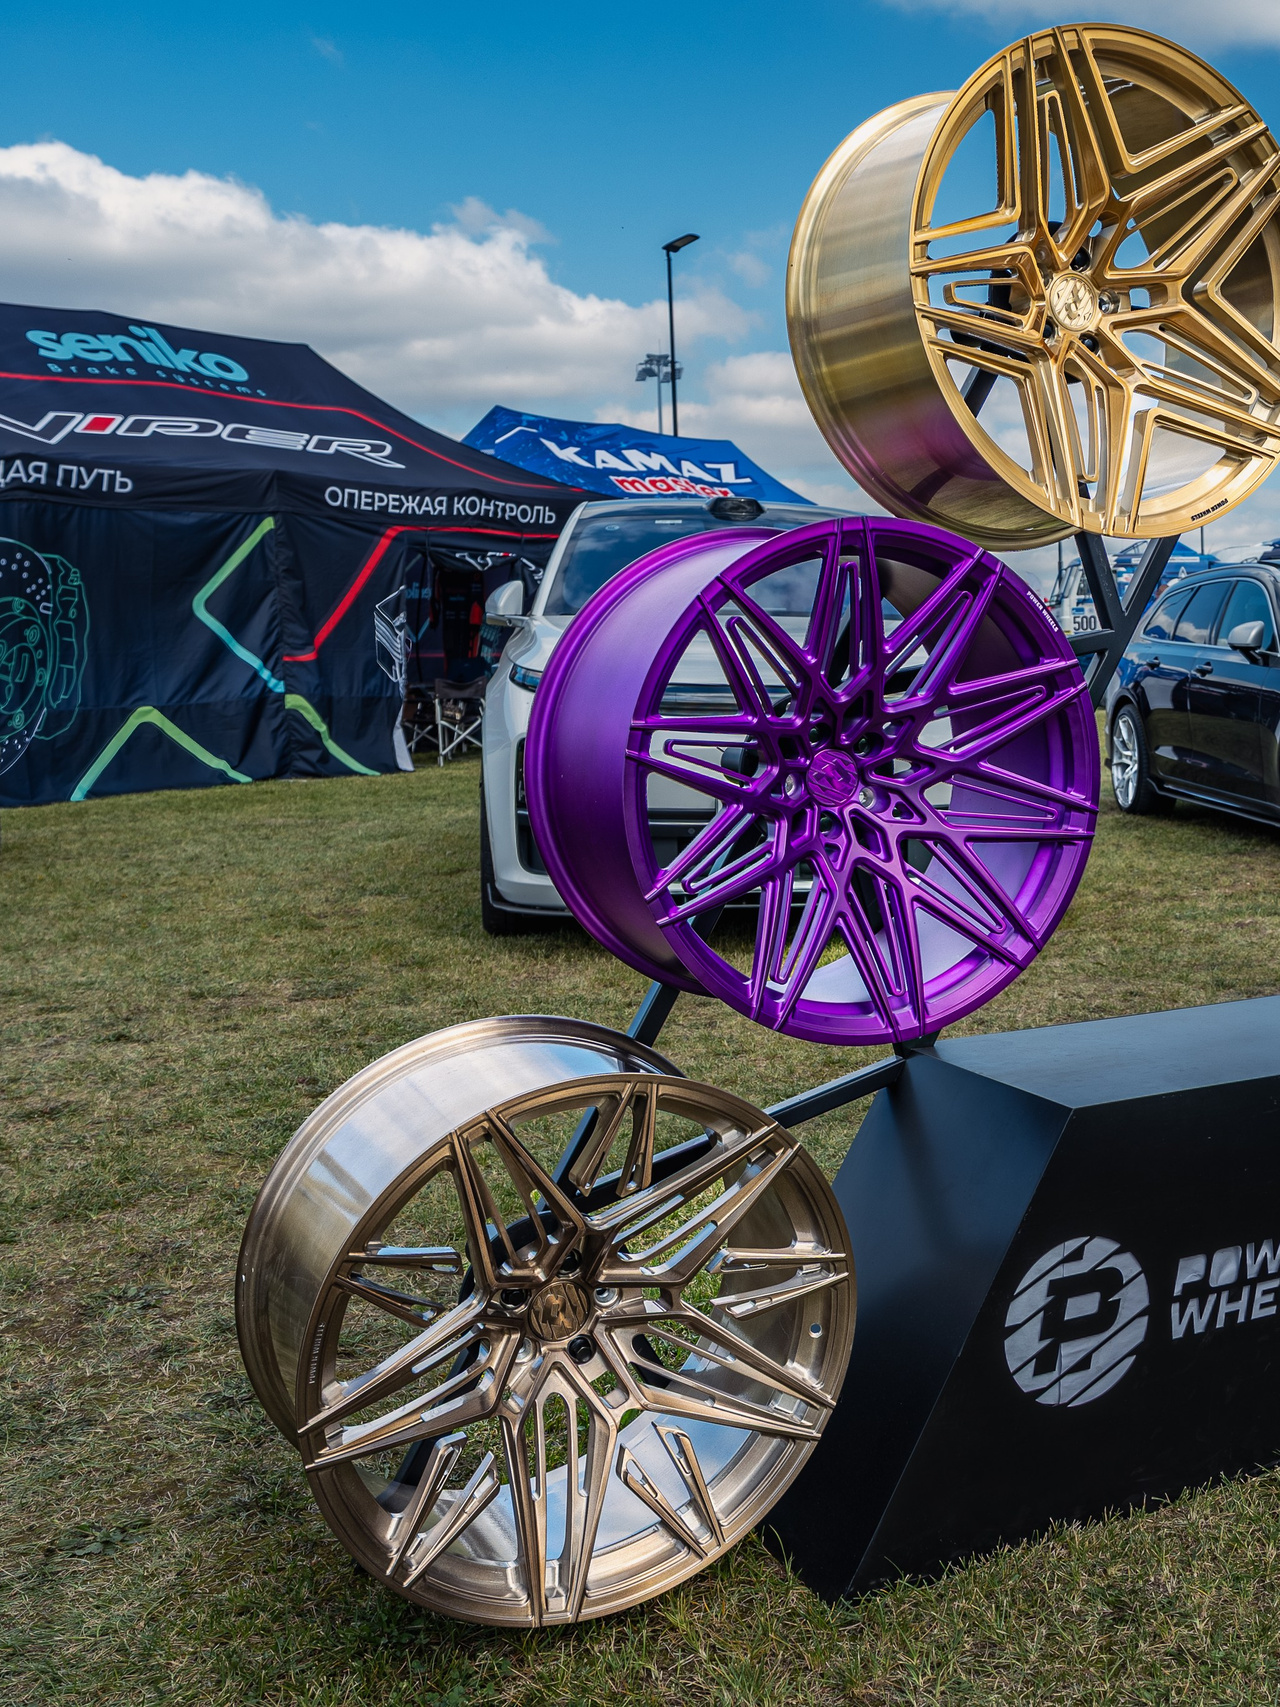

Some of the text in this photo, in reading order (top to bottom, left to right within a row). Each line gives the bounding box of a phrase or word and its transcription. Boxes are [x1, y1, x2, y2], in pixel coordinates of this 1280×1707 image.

[25, 324, 250, 383] seniko
[46, 362, 139, 377] Brake
[0, 410, 406, 470] VIPER
[0, 458, 134, 494] АЯ ПУТЬ
[539, 437, 753, 484] KAMAZ
[324, 485, 557, 525] ОПЕРЕЖАЯ КОНТРОЛЬ
[609, 474, 737, 498] master
[1026, 590, 1059, 633] POWER WHEELS
[1073, 615, 1097, 632] 500
